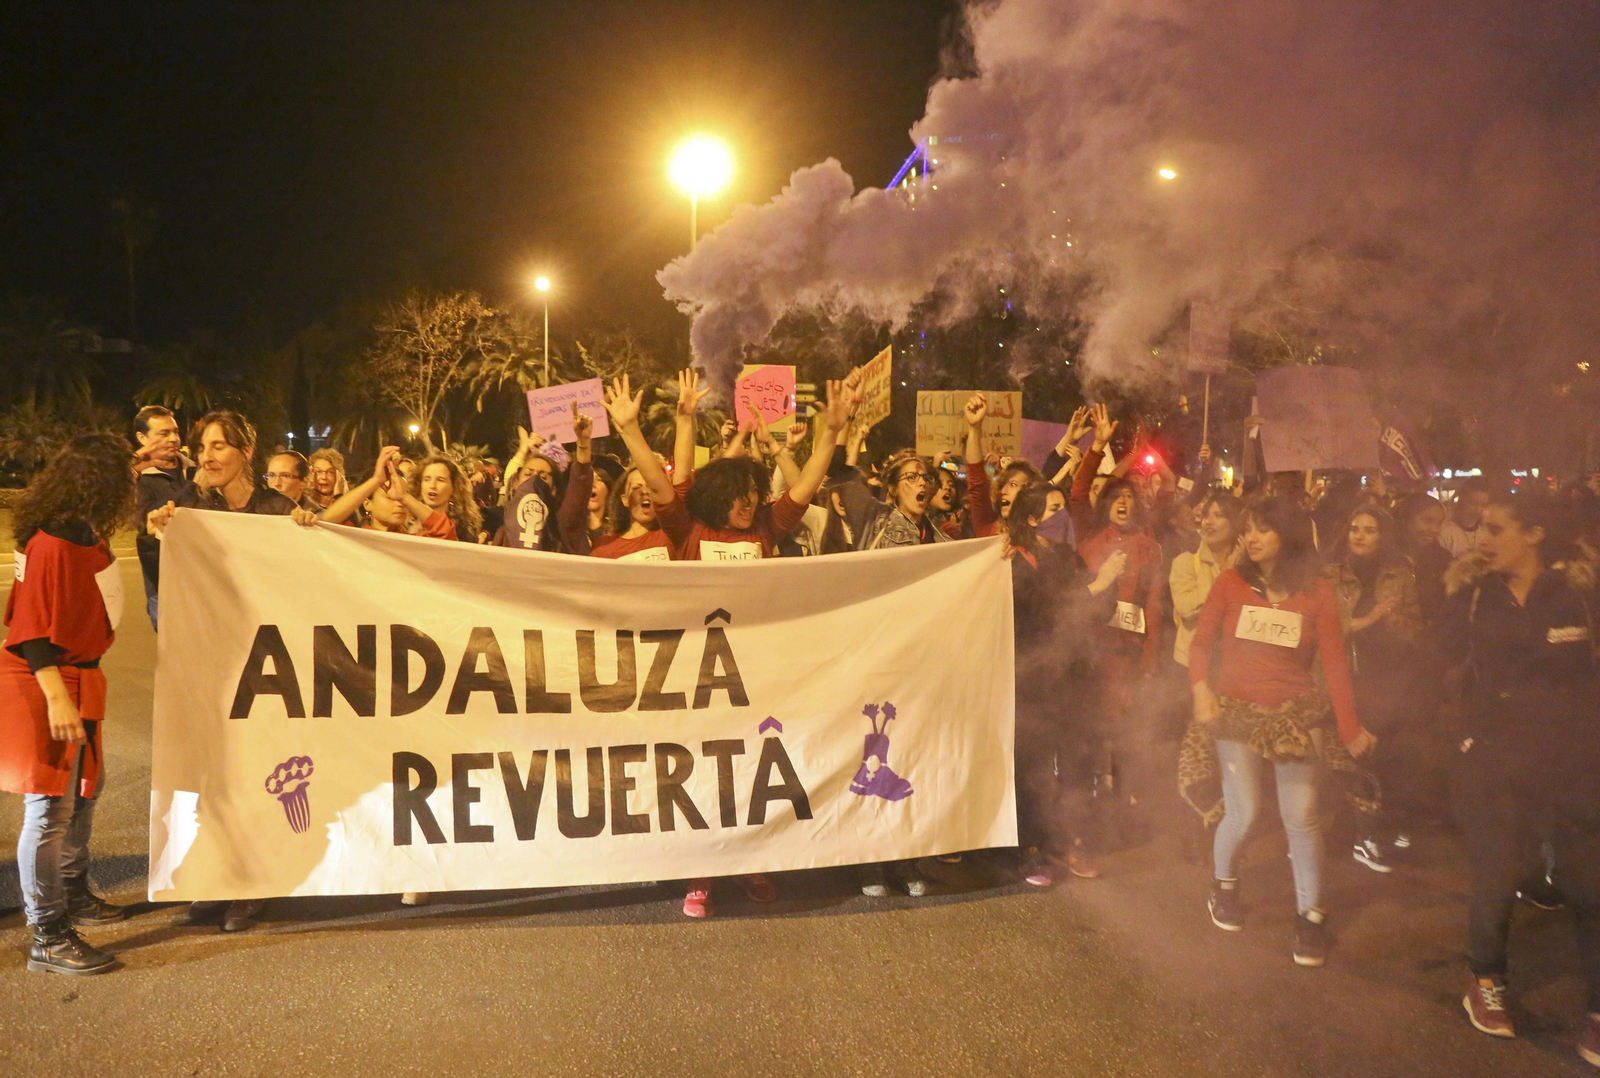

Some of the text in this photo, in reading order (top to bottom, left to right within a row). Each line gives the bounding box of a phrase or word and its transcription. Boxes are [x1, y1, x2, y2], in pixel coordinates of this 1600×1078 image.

[229, 607, 750, 719] ANDALUZÂ
[1245, 610, 1299, 641] JUNTAS
[392, 716, 813, 846] REVUERTÂ
